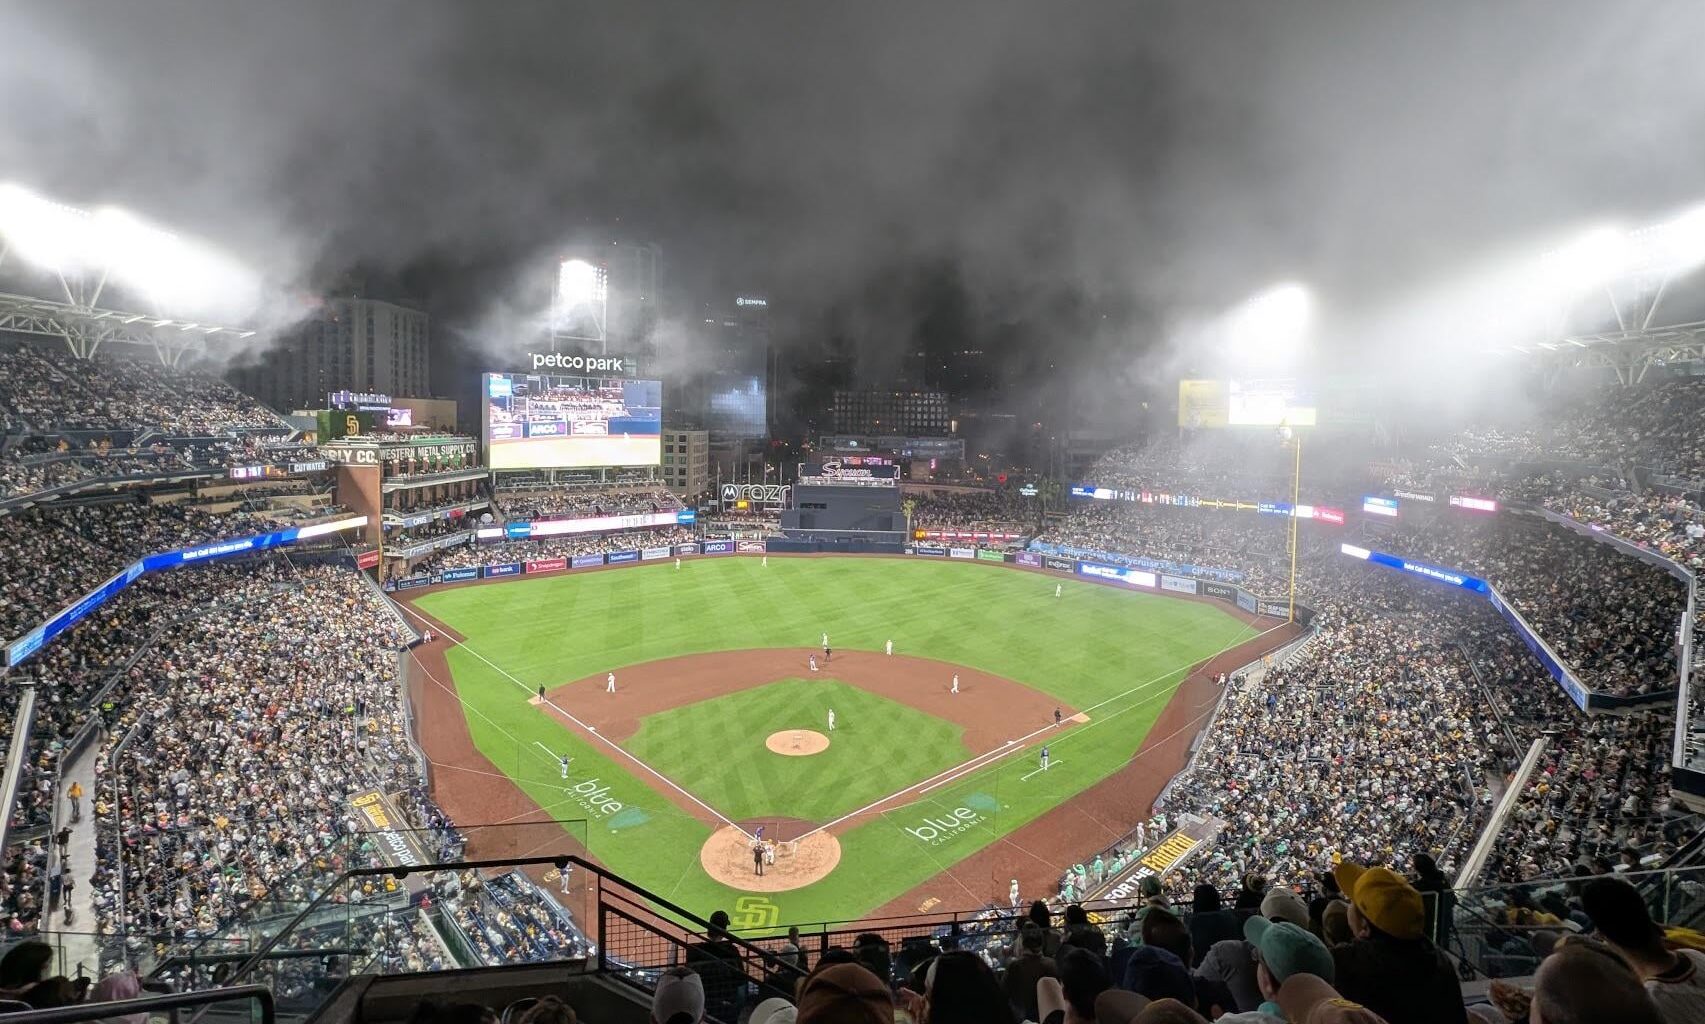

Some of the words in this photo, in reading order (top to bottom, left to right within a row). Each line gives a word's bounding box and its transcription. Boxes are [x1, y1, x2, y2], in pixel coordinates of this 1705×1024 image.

[533, 352, 583, 370] petco
[586, 357, 622, 373] park
[356, 450, 378, 463] CO.
[380, 447, 415, 460] WESTERN
[418, 445, 440, 457] METAL
[441, 444, 464, 456] SUPPLY
[294, 462, 326, 472] CUTWATER
[822, 461, 872, 480] Sycuan
[741, 484, 791, 502] razr
[706, 544, 726, 552] ARCO
[452, 571, 476, 579] Palomar
[1207, 587, 1230, 595] SONY
[564, 788, 600, 818] CALIFORNIA
[574, 779, 622, 814] blue
[905, 808, 976, 841] blue
[932, 815, 987, 846] CALIFORNIA
[378, 829, 406, 851] petco
[1104, 883, 1135, 904] FOR
[1126, 867, 1155, 886] THE
[733, 896, 779, 934] SD
